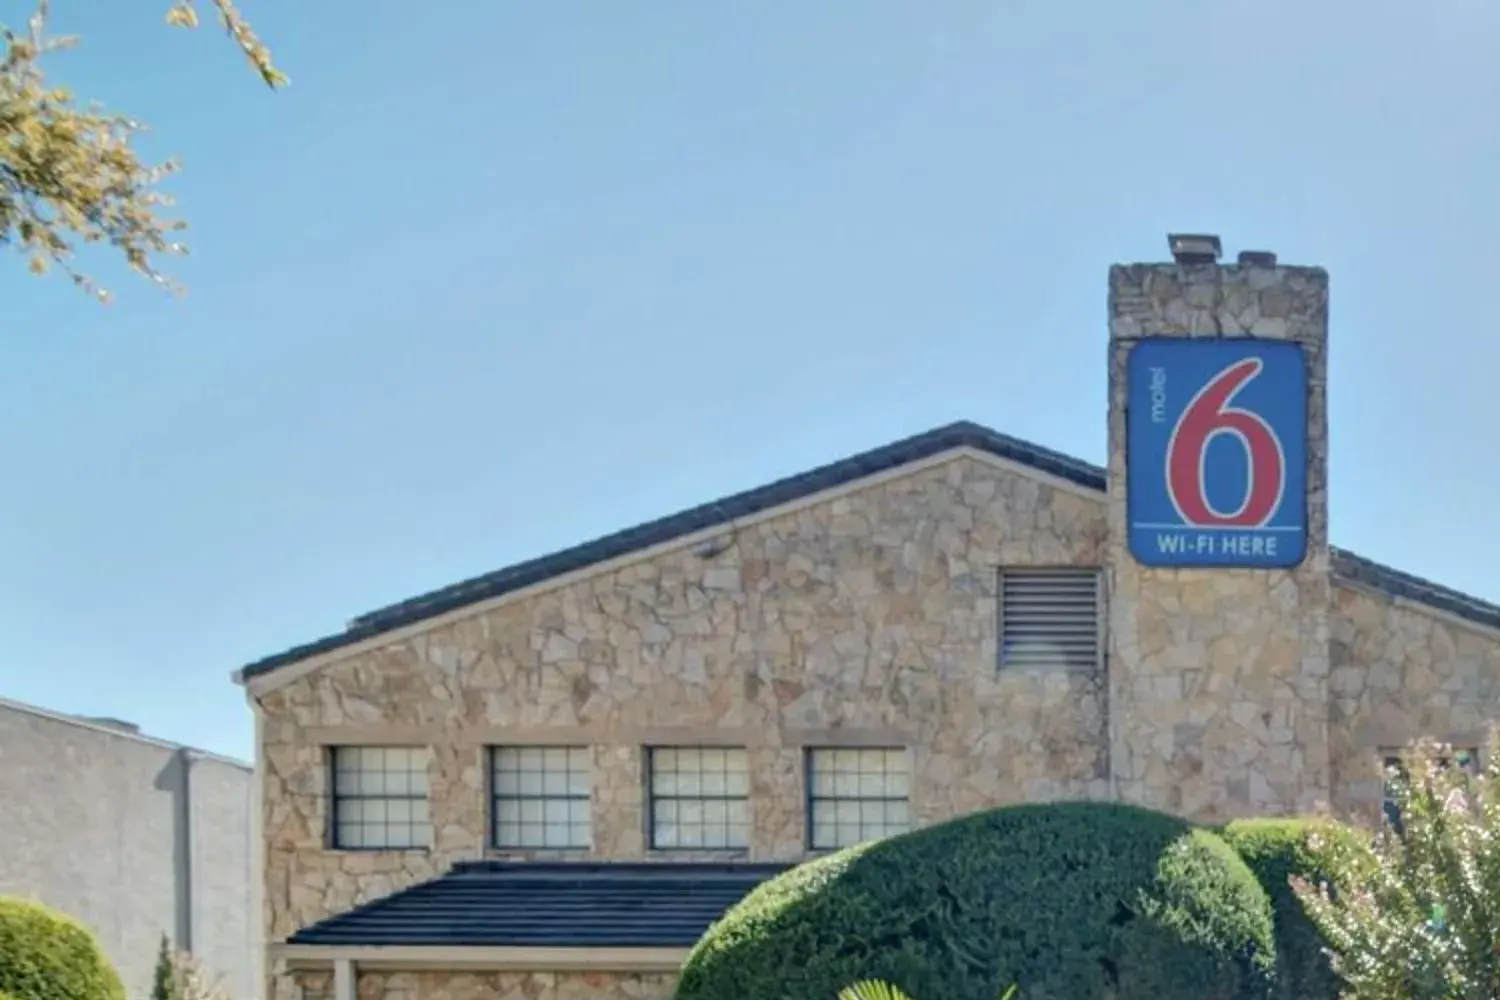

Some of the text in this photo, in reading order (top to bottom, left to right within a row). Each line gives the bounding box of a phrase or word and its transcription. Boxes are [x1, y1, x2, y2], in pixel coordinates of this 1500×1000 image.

[1149, 366, 1166, 423] motel
[1165, 357, 1286, 528] 6
[1156, 533, 1278, 557] WI-FI HERE
